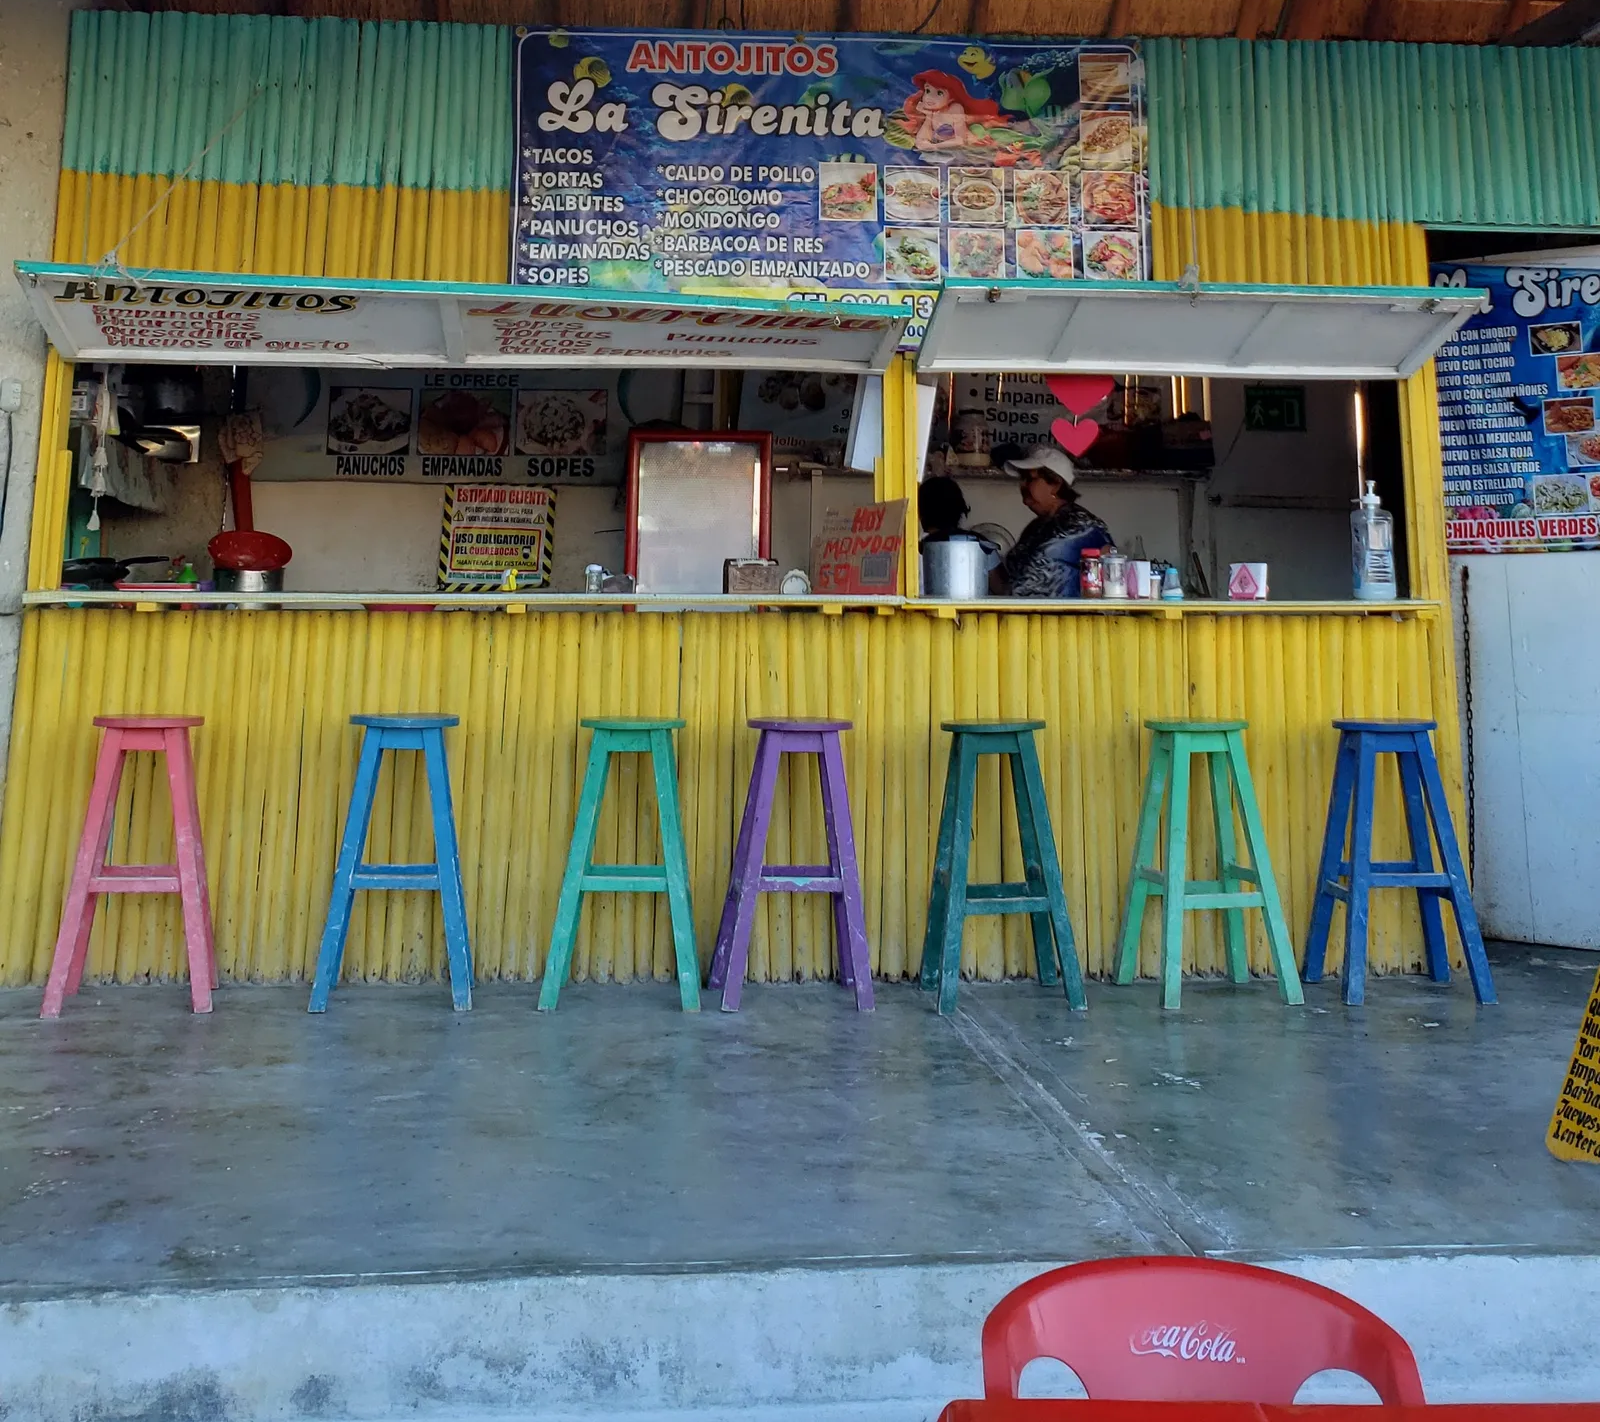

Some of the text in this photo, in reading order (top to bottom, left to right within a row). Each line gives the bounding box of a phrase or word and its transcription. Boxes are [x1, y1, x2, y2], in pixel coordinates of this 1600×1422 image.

[625, 41, 838, 77] ANTOJITOS
[538, 79, 885, 141] La Sirenita
[532, 148, 593, 165] TACOS
[531, 172, 603, 189] TORTAS
[664, 165, 816, 183] CALDO DE POLLO
[530, 196, 624, 212] SALBUTES
[664, 188, 783, 206] CHOCOLOMO
[529, 219, 639, 236] PANUCHOS
[663, 212, 781, 229] MONDONGO
[528, 243, 651, 261] EMPANADAS
[663, 236, 824, 253] BARBACOA DE RES
[527, 266, 589, 284] SOPES
[662, 259, 870, 278] PESCADO EMPANIZADO
[493, 318, 584, 329] Sopes
[667, 332, 820, 345] Panuchos
[1461, 330, 1479, 341] CON
[1480, 326, 1517, 339] CHORIZO
[1461, 344, 1479, 356] CON
[1462, 358, 1481, 370] CON
[1482, 356, 1515, 369] TOCINO
[424, 374, 519, 387] LE OFRECE
[1463, 373, 1482, 385] CON
[1483, 371, 1511, 384] CHAYA
[1463, 388, 1483, 400] CON
[1484, 384, 1549, 399] CHAMPIÑONES
[985, 407, 1039, 426] Sopes
[1464, 403, 1484, 415] CON
[1485, 402, 1515, 414] CARNE
[1466, 416, 1525, 430] VEGETARIANO
[1468, 434, 1474, 445] A
[1475, 433, 1485, 445] LA
[1486, 430, 1533, 444] MEXICANA
[1470, 449, 1481, 459] EN
[1481, 447, 1509, 460] SALSA
[1510, 446, 1533, 458] ROJA
[336, 455, 595, 477] PANUCHOS EMPANADAS SOPES
[1472, 464, 1482, 475] EN
[1483, 462, 1510, 475] SALSA
[1510, 461, 1541, 473] VERDE
[1443, 477, 1524, 491] HUEVO ESTRELLADO
[457, 488, 547, 505] ESTIMADO CLIENTE
[1444, 493, 1514, 507] HUEVO REVUELTO
[851, 506, 886, 534] HOY
[1444, 516, 1597, 540] CHILAQUILES VERDES
[455, 533, 536, 546] USO OBLIGATORIO
[455, 545, 467, 555] DEL
